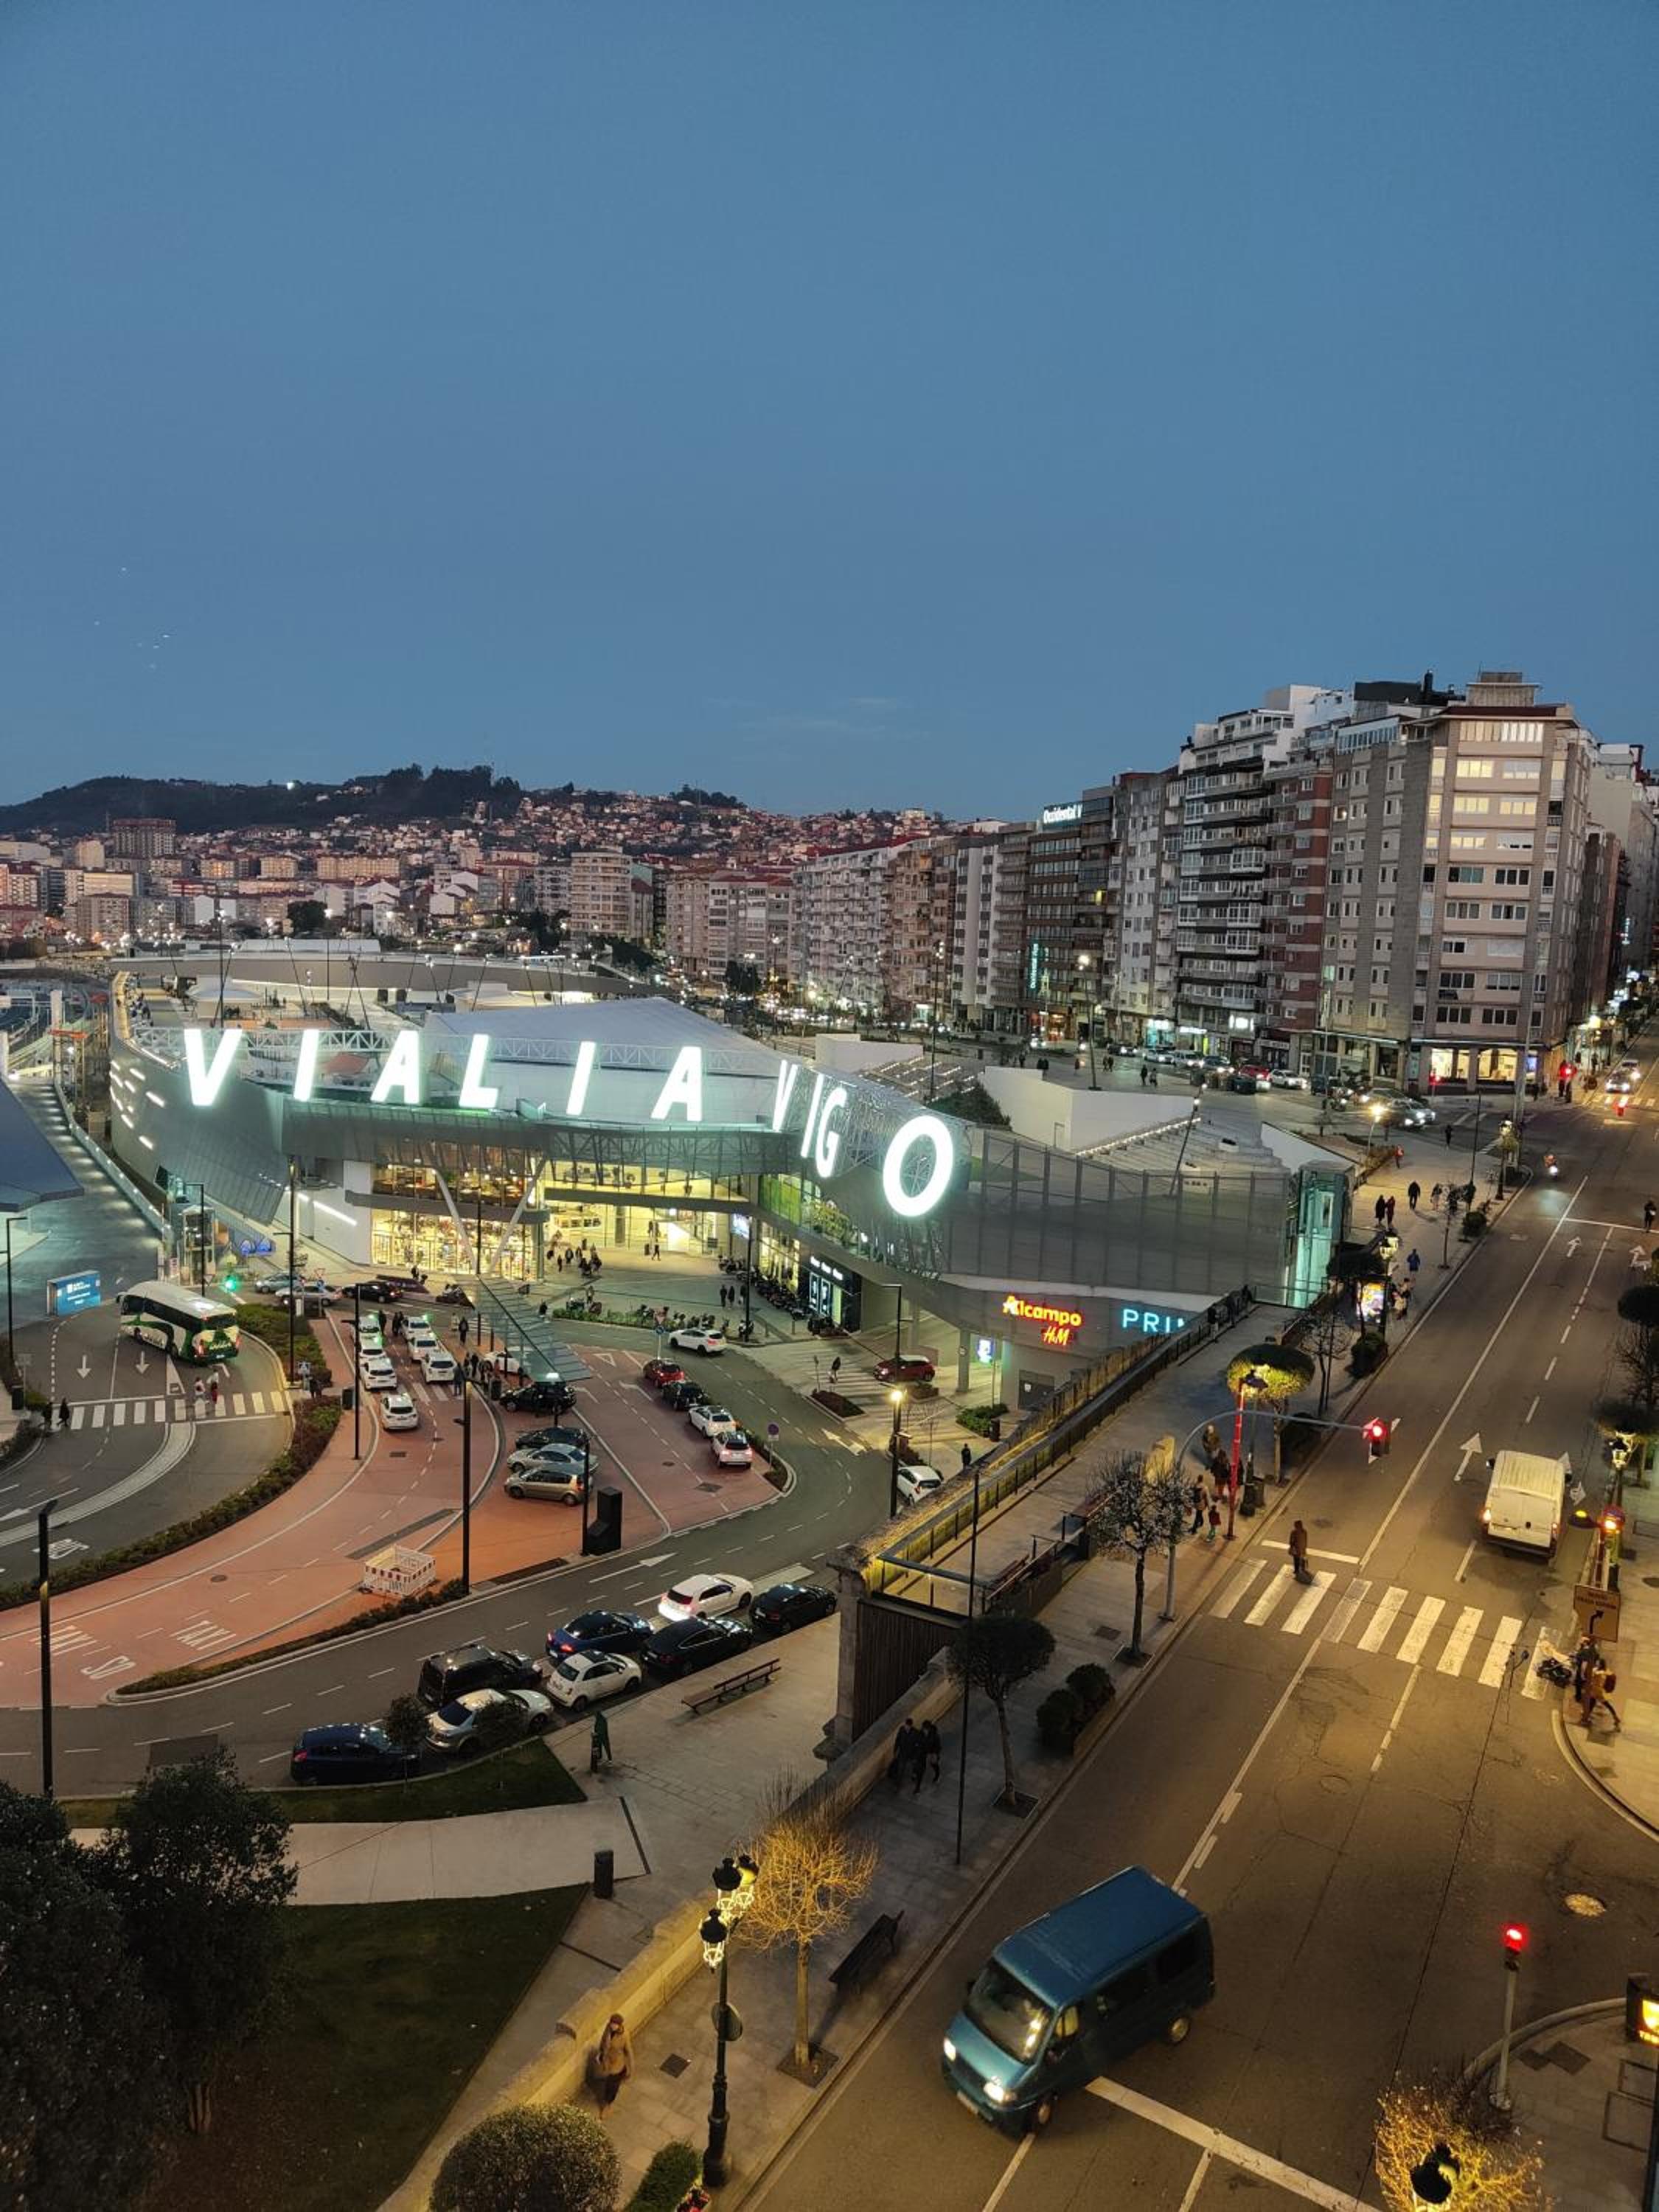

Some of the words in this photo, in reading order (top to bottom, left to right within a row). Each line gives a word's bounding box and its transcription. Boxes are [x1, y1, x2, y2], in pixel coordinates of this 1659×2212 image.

[184, 1028, 703, 1122] VIALIA
[772, 1060, 954, 1218] VIGO
[1003, 1295, 1082, 1326] Alcampo
[1123, 1308, 1185, 1333] PRI
